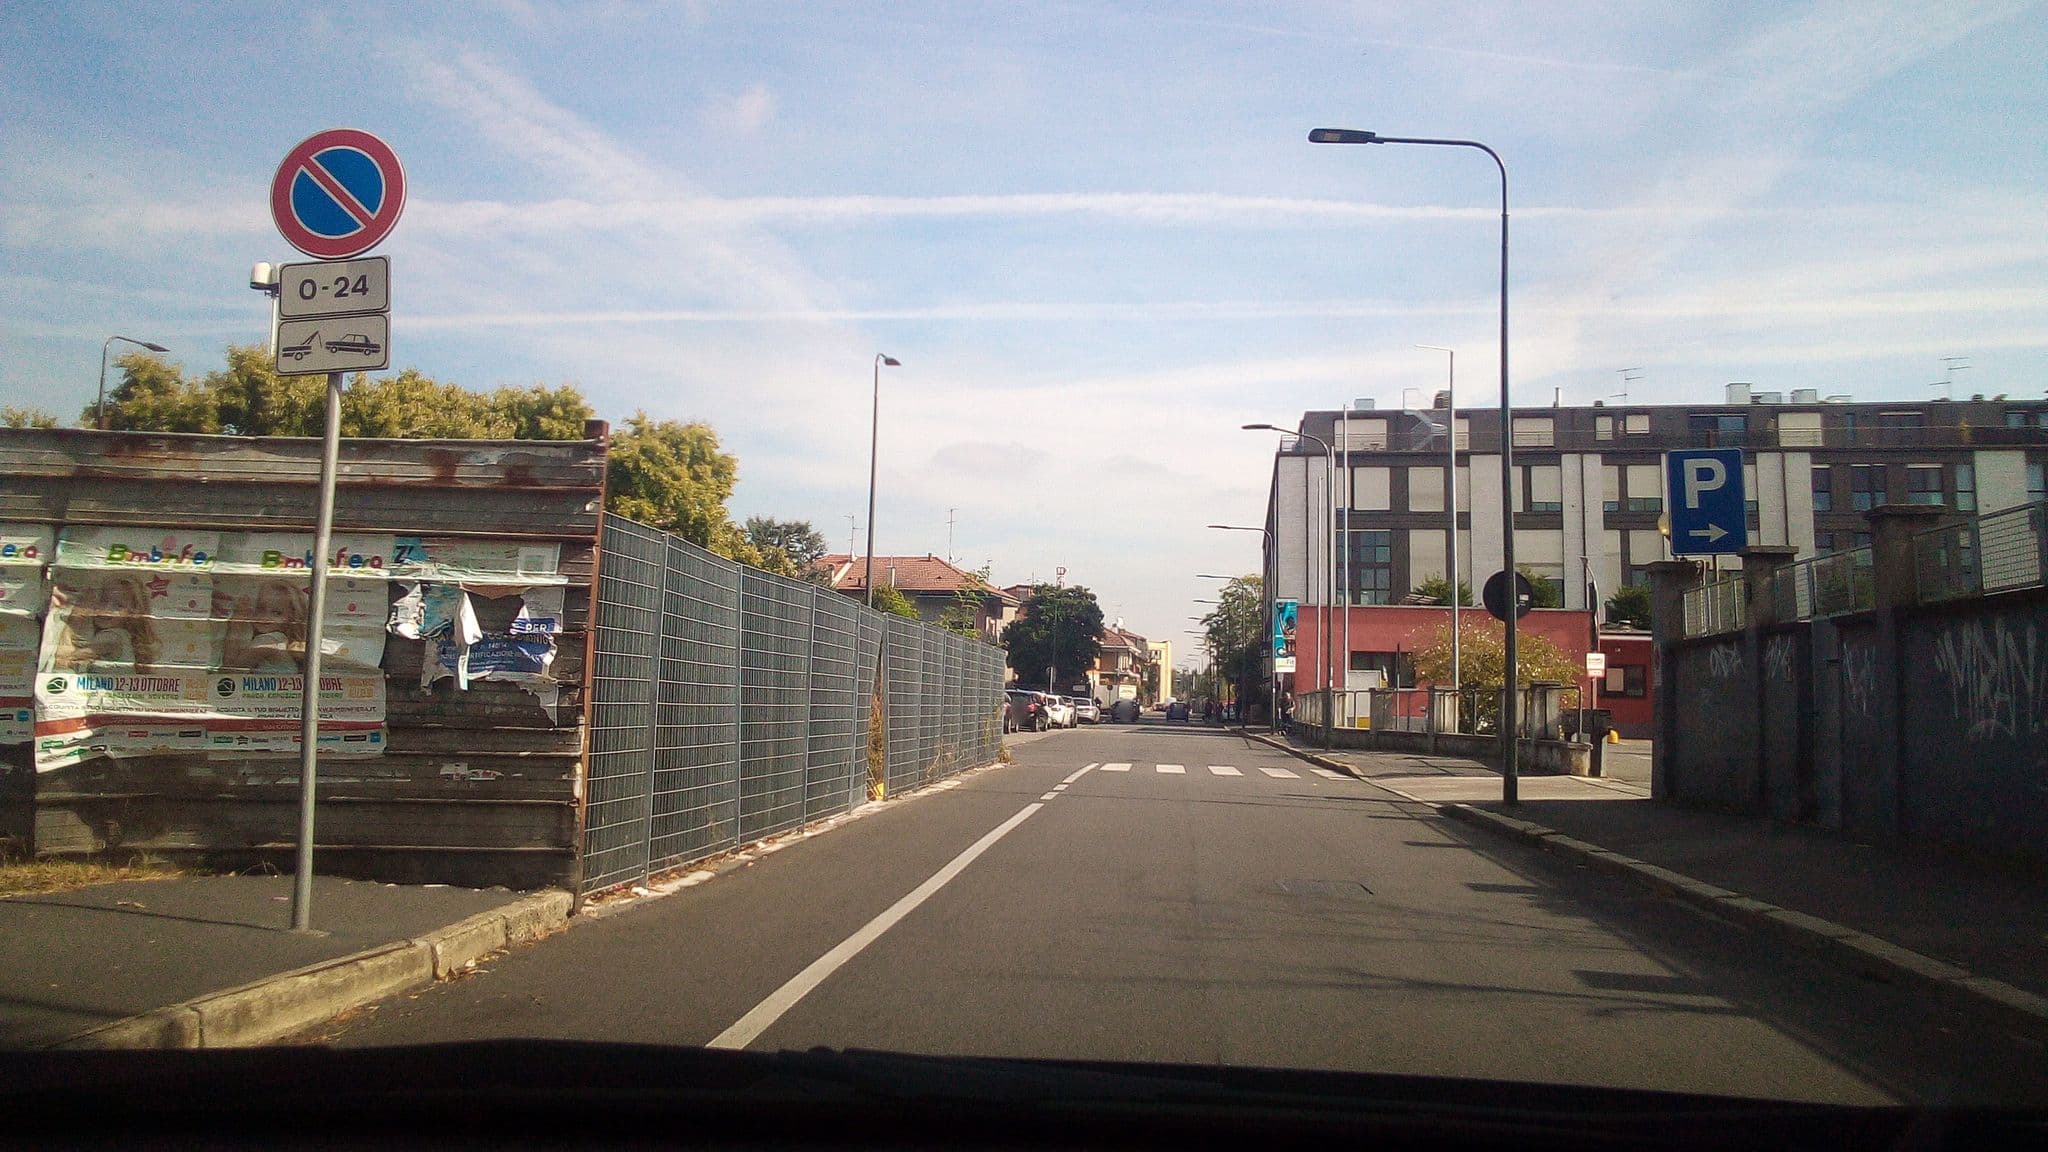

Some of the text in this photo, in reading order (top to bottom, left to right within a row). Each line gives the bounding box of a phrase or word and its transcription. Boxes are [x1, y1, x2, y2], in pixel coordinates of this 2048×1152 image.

[299, 274, 370, 300] 0-24
[1683, 458, 1727, 509] P
[77, 676, 114, 691] MILANO
[115, 677, 140, 692] 12-13
[141, 677, 180, 693] OTTOBRE
[242, 676, 277, 691] MILANO
[278, 677, 303, 691] 12-13
